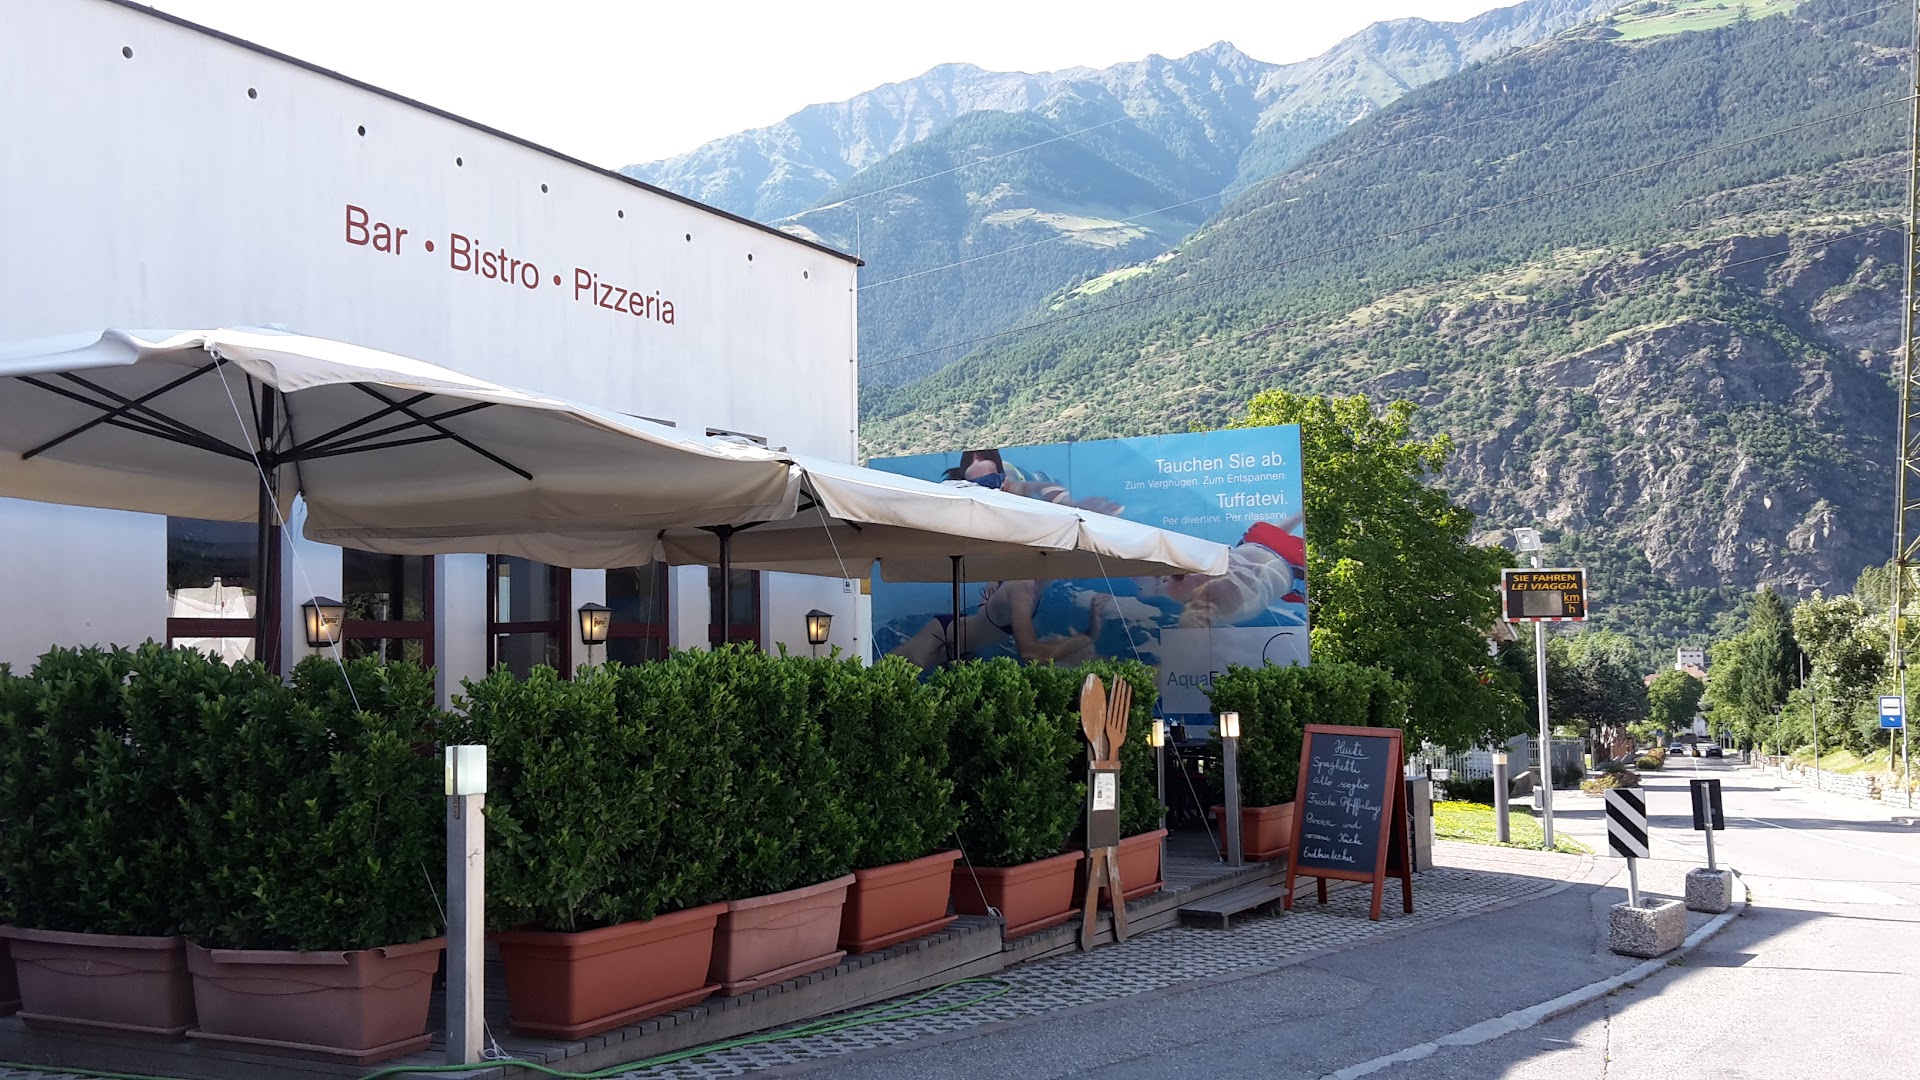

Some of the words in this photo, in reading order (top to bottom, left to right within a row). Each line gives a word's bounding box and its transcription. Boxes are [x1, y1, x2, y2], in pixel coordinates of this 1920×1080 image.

[346, 204, 408, 256] Bar
[450, 233, 540, 290] Bistro
[574, 267, 675, 326] Pizzeria
[1155, 456, 1223, 474] Tauchen
[1229, 453, 1256, 469] Sie
[1261, 451, 1287, 467] ab.
[1125, 480, 1145, 490] Zum
[1147, 477, 1200, 489] Vergnügen.
[1203, 474, 1224, 485] Zum
[1227, 472, 1287, 484] Entspannen.
[1216, 490, 1289, 508] Tuffatevi.
[1163, 516, 1178, 525] Per
[1225, 513, 1241, 522] Per
[1244, 511, 1289, 521] rilassarvi.
[1513, 574, 1530, 582] SIE
[1563, 592, 1580, 602] km
[1568, 604, 1576, 613] h
[1334, 740, 1365, 756] Heute
[1312, 756, 1361, 775] Spaghetti
[1342, 820, 1362, 829] und
